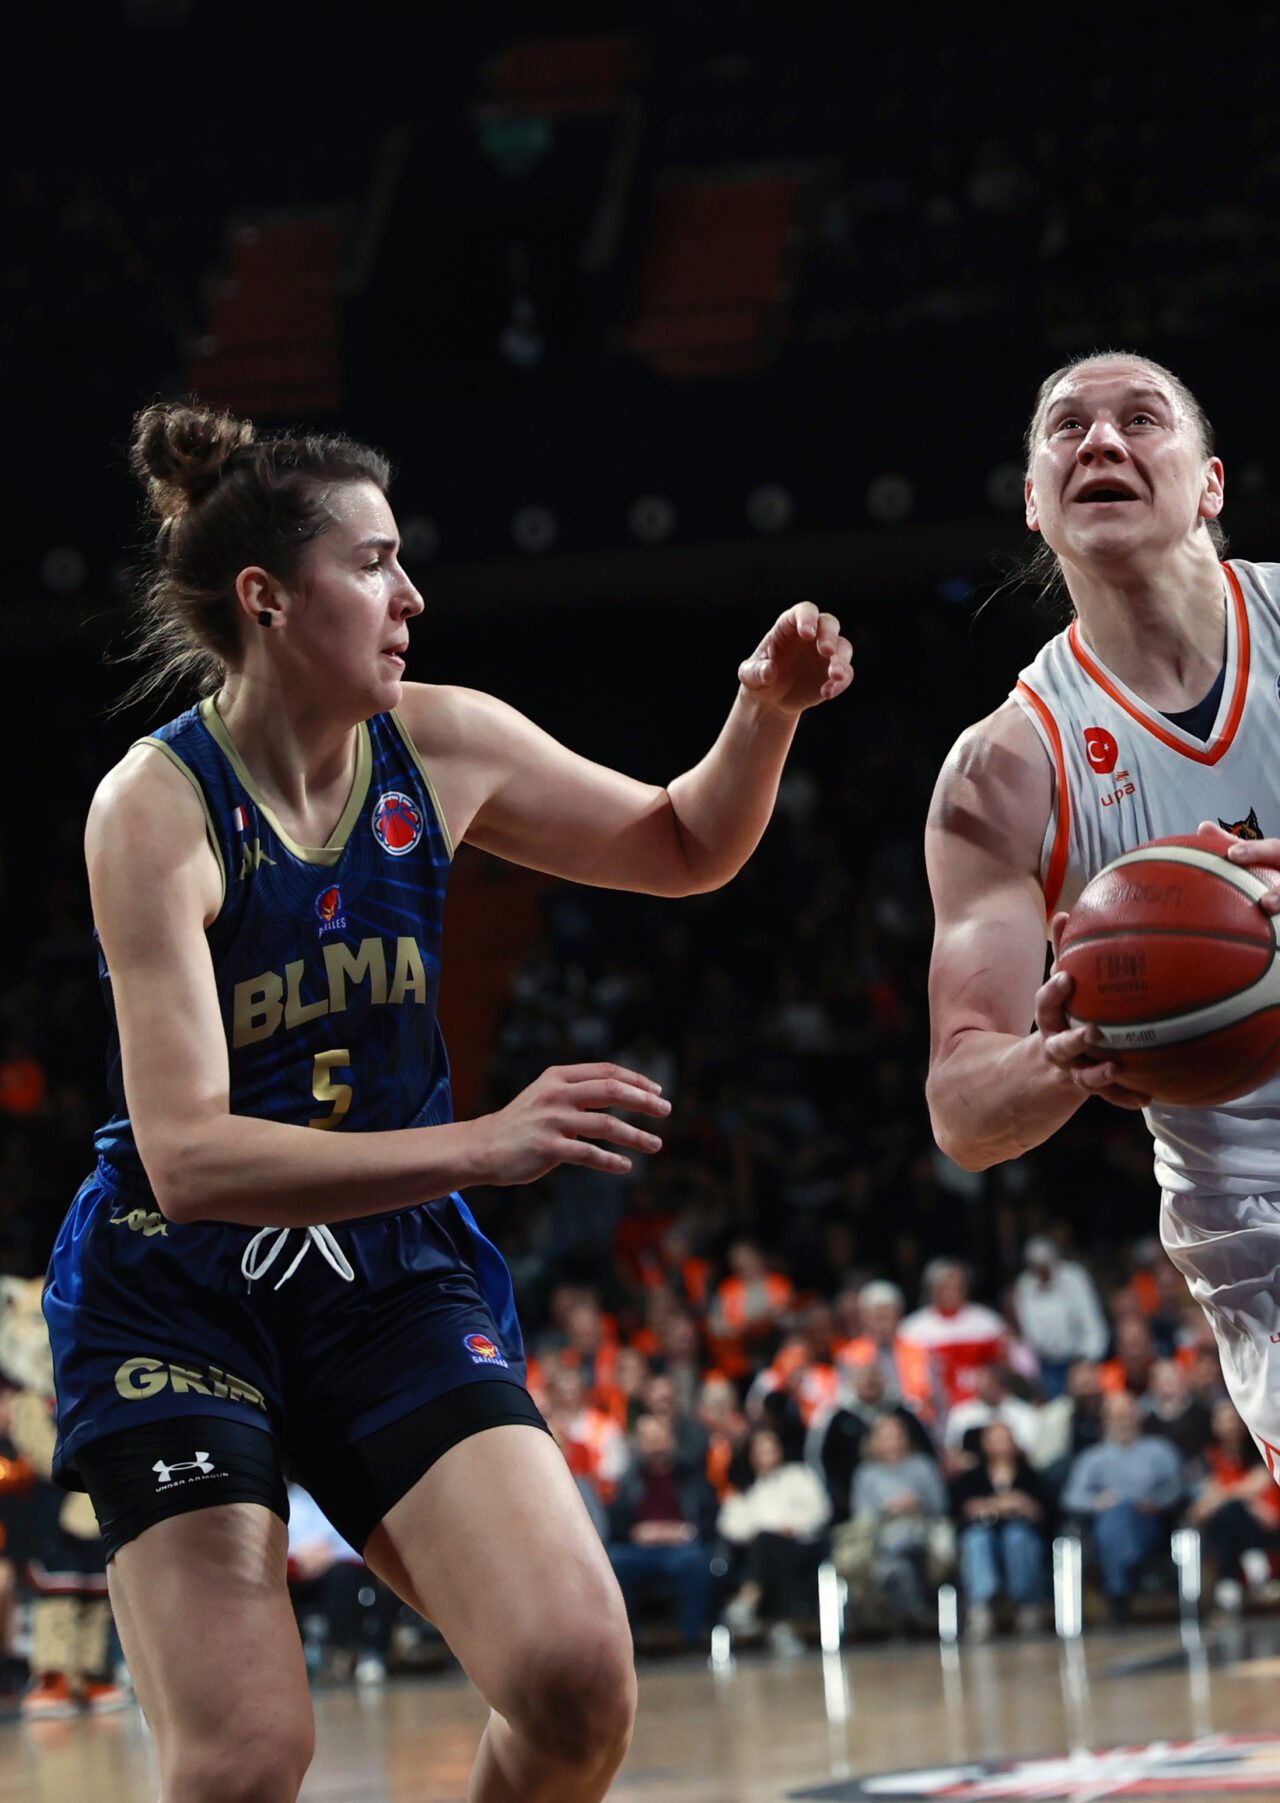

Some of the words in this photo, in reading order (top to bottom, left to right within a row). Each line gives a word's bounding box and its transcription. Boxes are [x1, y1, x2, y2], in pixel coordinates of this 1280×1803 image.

[1101, 782, 1136, 807] upa
[233, 936, 426, 1049] BLMA
[309, 1048, 353, 1130] 5
[155, 1478, 186, 1493] UNDER
[188, 1472, 229, 1483] ARMOUR
